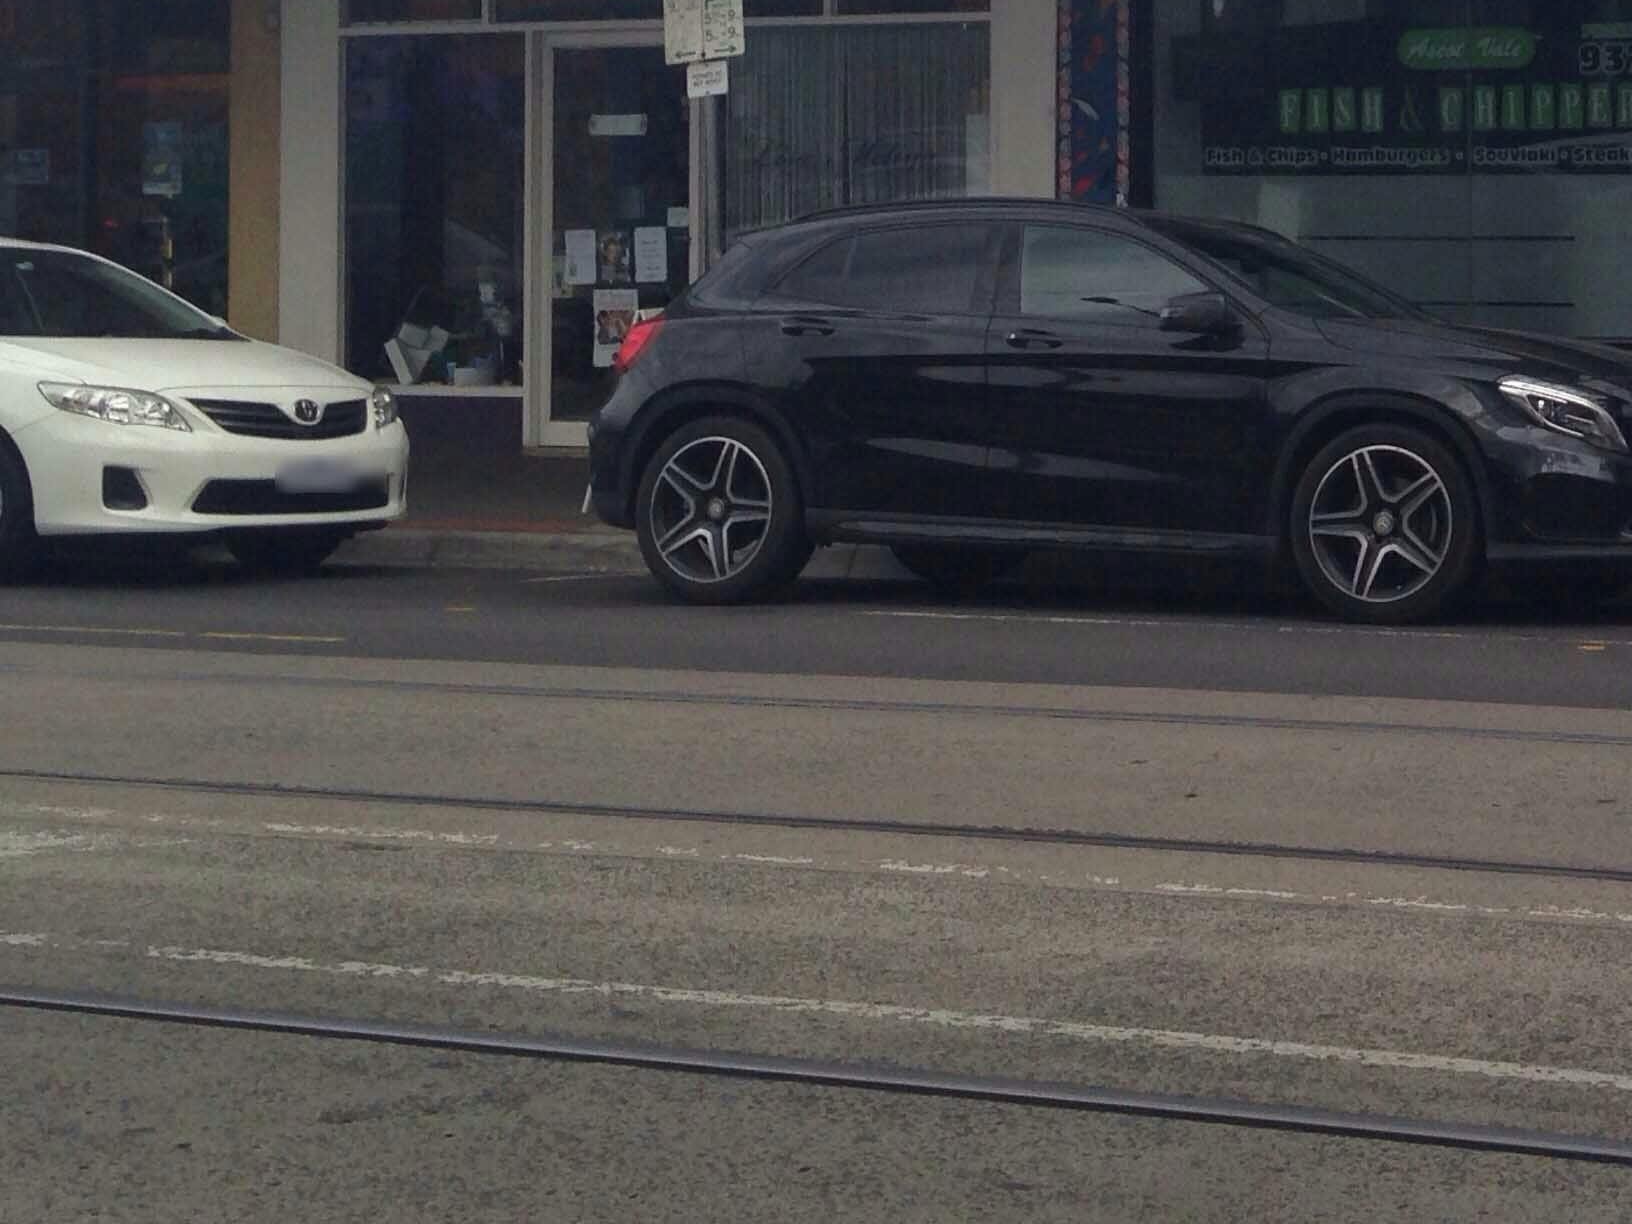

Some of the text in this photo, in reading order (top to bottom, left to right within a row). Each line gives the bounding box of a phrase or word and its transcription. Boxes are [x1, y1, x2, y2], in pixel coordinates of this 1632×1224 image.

[1280, 88, 1384, 133] FISH
[1206, 147, 1245, 166] Fish
[1266, 147, 1319, 168] Chips
[1331, 145, 1450, 168] Hamburgers
